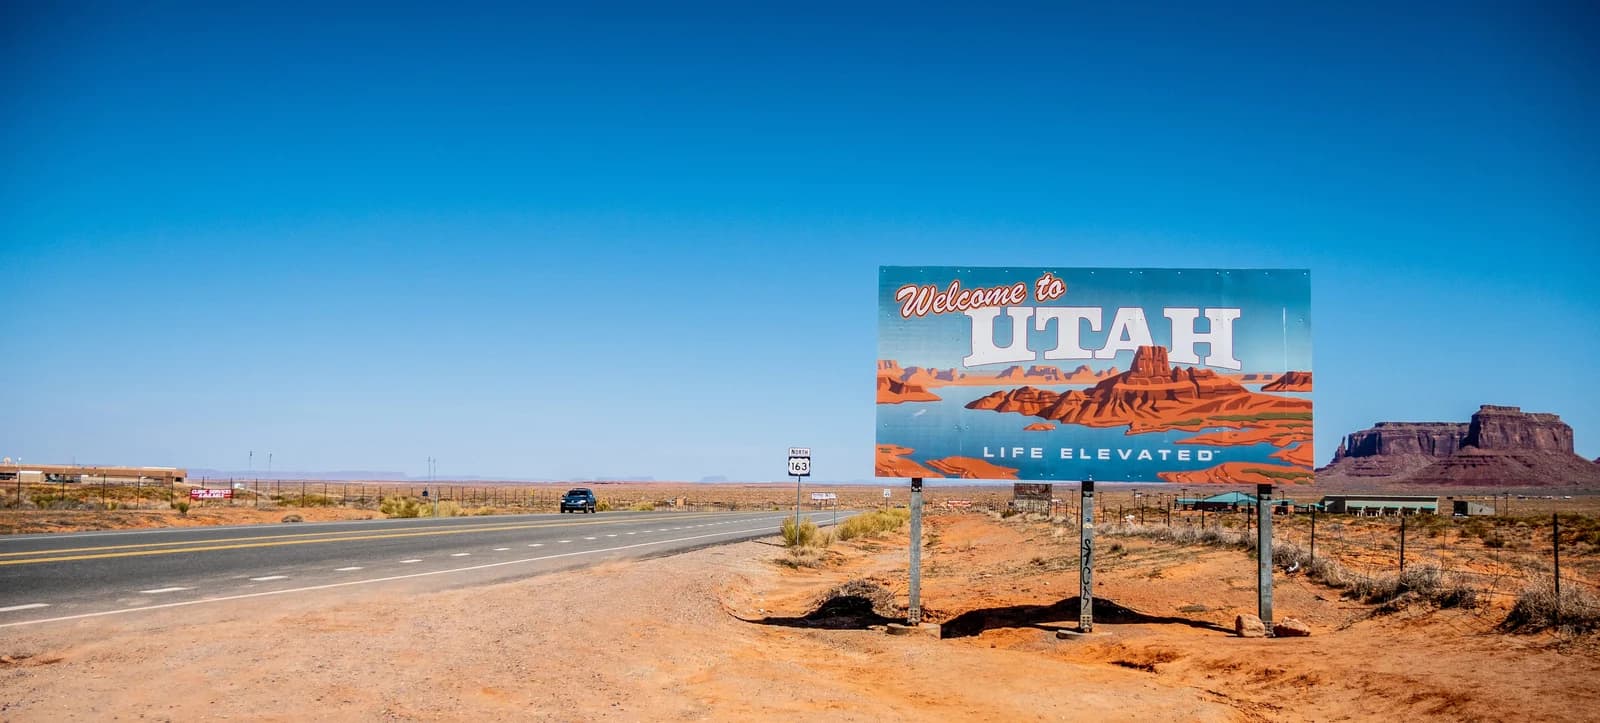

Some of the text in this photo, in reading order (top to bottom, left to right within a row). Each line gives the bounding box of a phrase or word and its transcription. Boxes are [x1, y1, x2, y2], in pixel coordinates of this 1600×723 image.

[896, 273, 1065, 319] Welcome to
[963, 307, 1241, 370] UTAH
[791, 462, 807, 471] 163
[984, 446, 1214, 462] LIFE ELEVATED
